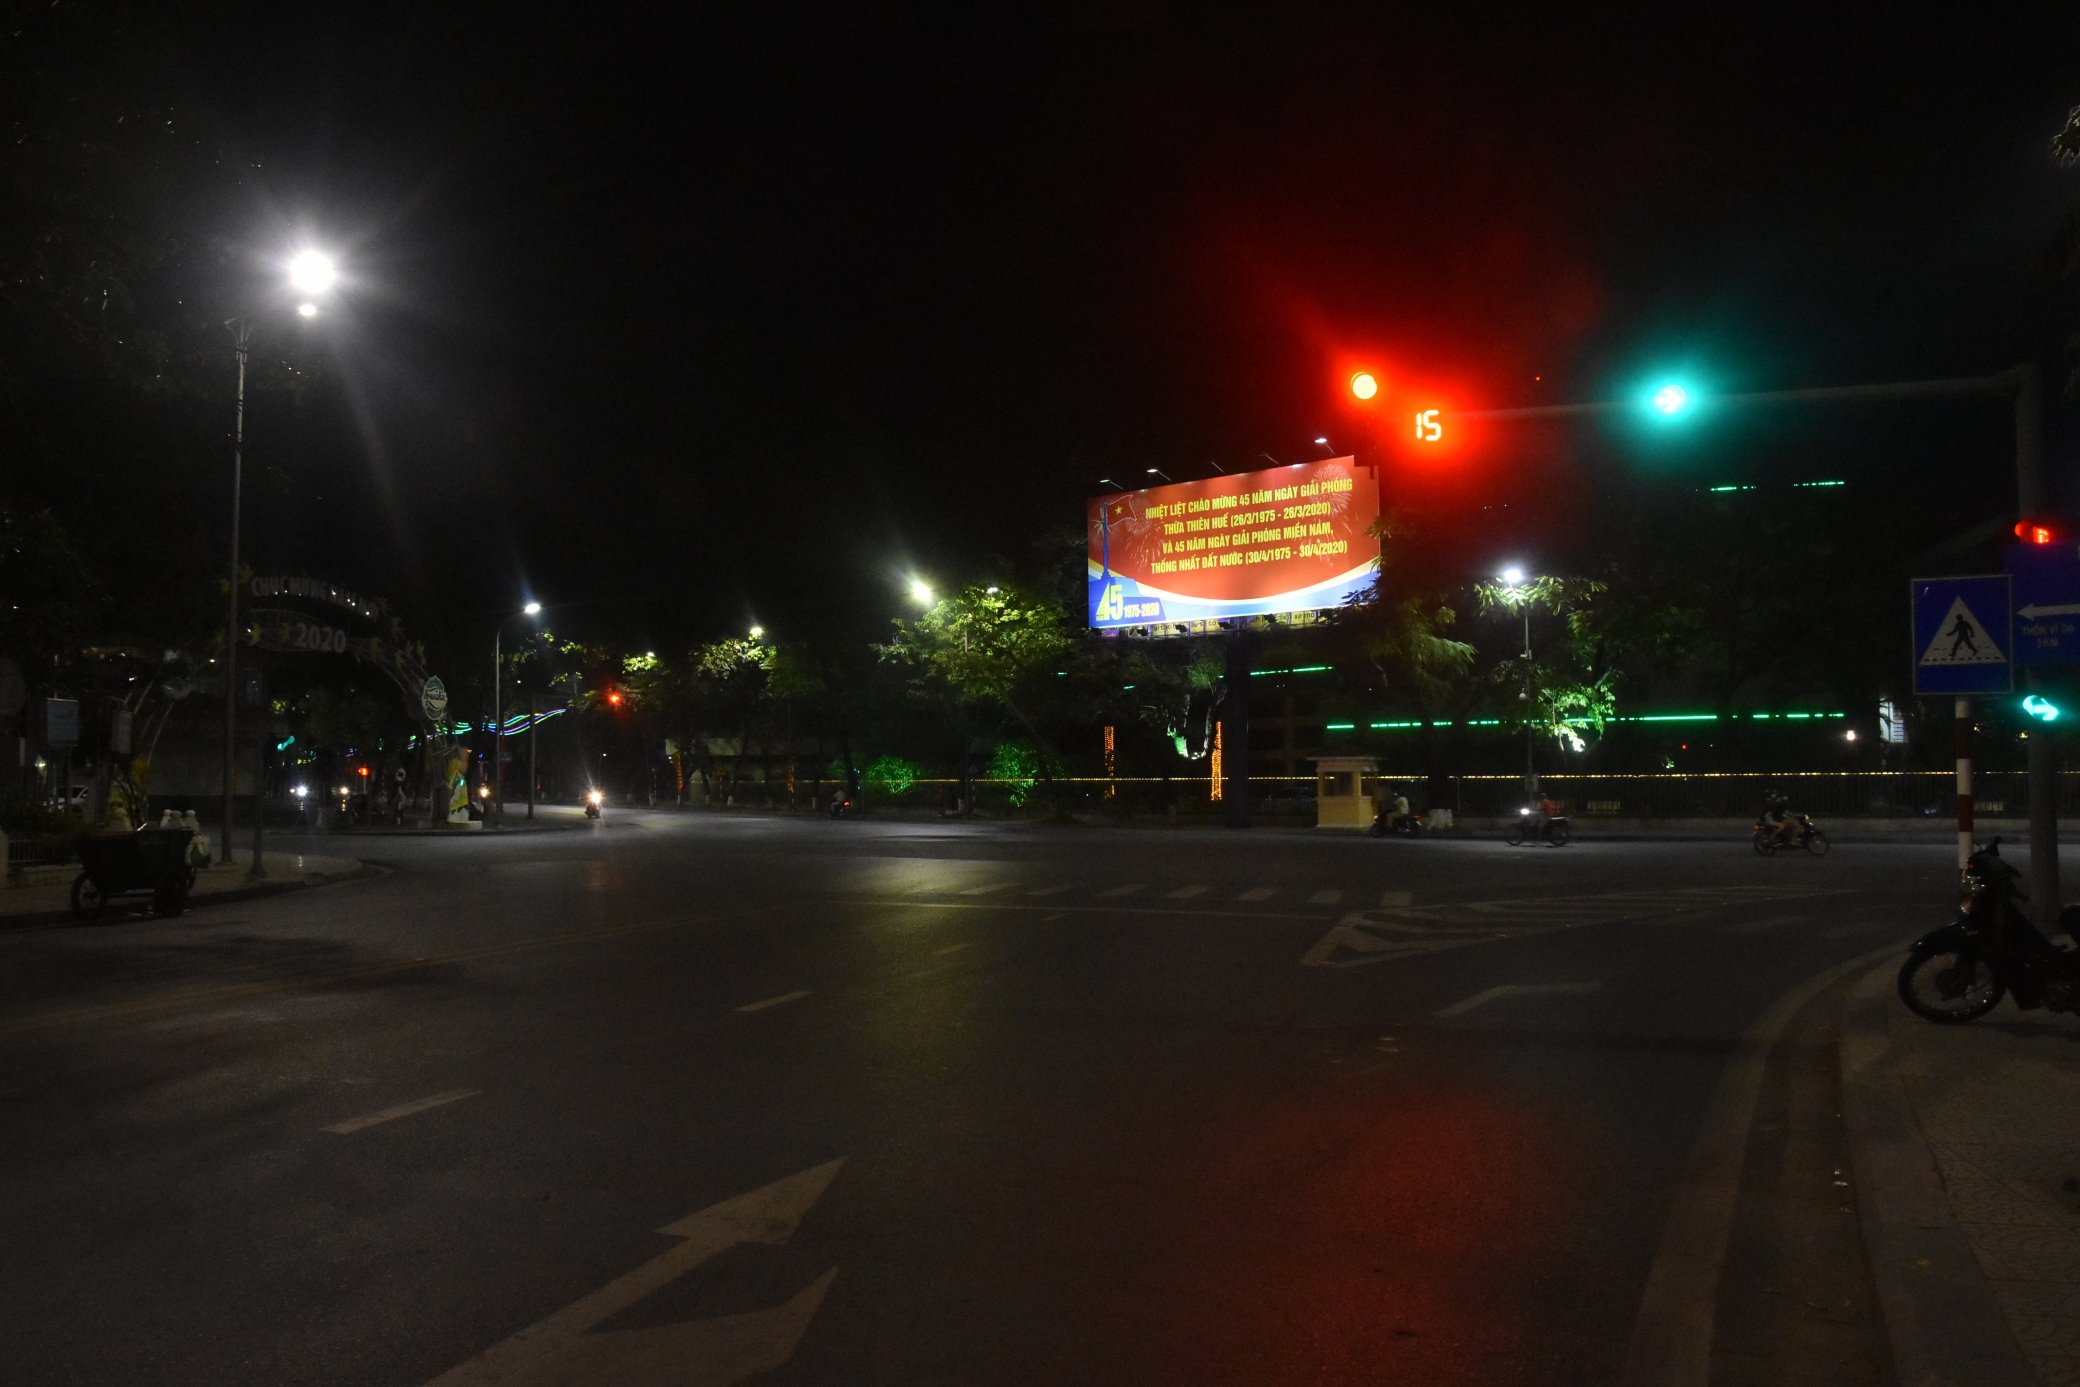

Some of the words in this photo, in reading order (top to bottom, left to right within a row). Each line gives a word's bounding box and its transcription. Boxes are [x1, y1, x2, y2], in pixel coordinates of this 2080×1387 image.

[1416, 409, 1442, 441] 15
[1145, 503, 1168, 520] NHIỆT
[1170, 501, 1186, 517] LIỆT
[1188, 498, 1210, 513] CHÀO
[1212, 495, 1237, 510] MỪNG
[1239, 493, 1250, 506] 45
[1252, 489, 1272, 504] NĂM
[1274, 485, 1298, 501] NGÀY
[1300, 480, 1319, 497] GIẢI
[1164, 520, 1184, 535] THỪA
[1186, 517, 1210, 532] THIÊN
[1212, 512, 1228, 529] HUẾ
[1231, 510, 1276, 527] (26/3/1975
[1162, 539, 1173, 554] VÀ
[1175, 541, 1185, 553] 45
[1186, 536, 1206, 551] NĂM
[1208, 533, 1230, 548] NGÀY
[1232, 529, 1250, 546] GIẢI
[1151, 557, 1177, 574] THỐNG
[1179, 553, 1200, 571] NHẤT
[1202, 552, 1218, 569] ĐẤT
[1219, 550, 1243, 567] NƯỚC
[1245, 547, 1291, 565] (30/4/1975
[1095, 581, 1124, 621] 45
[1124, 602, 1160, 619] 1975-2020
[294, 622, 346, 653] 2020
